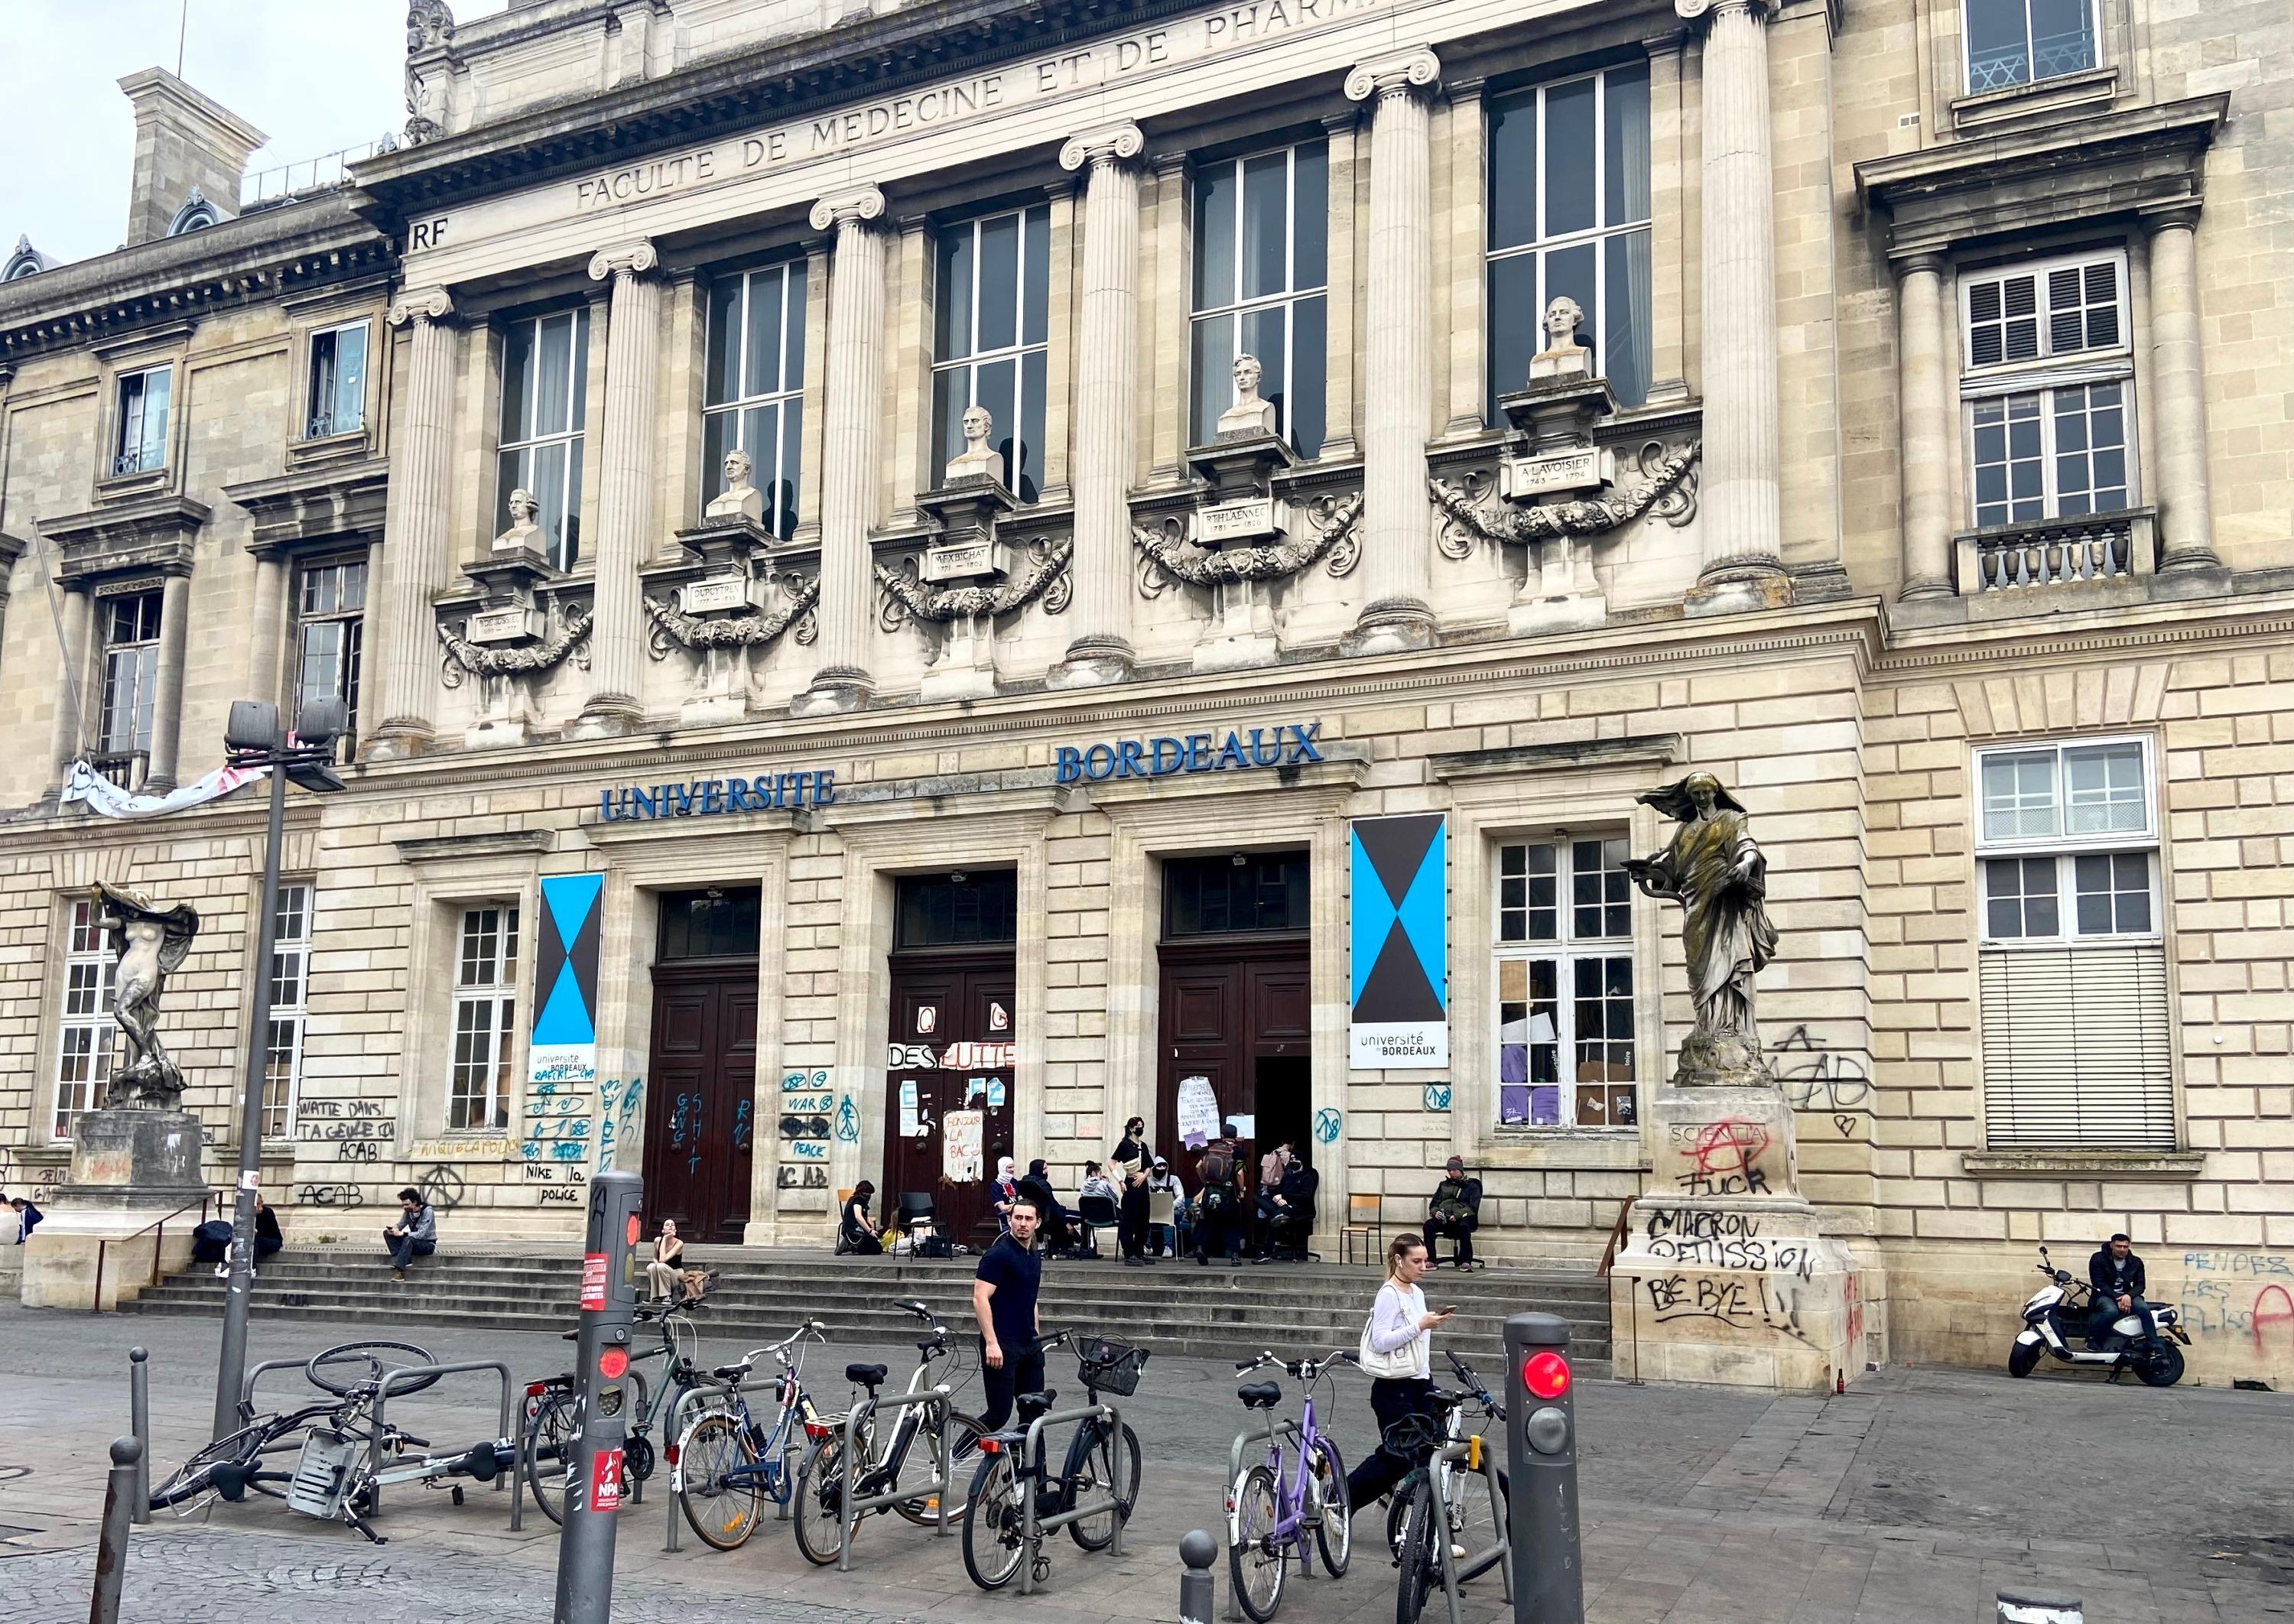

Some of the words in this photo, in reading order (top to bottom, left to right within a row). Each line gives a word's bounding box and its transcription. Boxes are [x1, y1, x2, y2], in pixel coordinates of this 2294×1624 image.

[576, 151, 715, 209] FACULTE
[742, 132, 787, 168] DE
[811, 75, 1003, 151] MEDECINE
[1036, 51, 1092, 93] ET
[1116, 31, 1168, 73] DE
[412, 218, 449, 250] RF
[1532, 457, 1591, 476] LAVOISIER
[694, 584, 739, 598] DUPUYTREN
[1054, 722, 1325, 783] BORDEAUX
[600, 769, 836, 821] UNIVERSITE
[919, 1007, 934, 1032] Q
[1360, 1031, 1424, 1046] université
[889, 1046, 937, 1070] DES
[1382, 1046, 1436, 1056] BORDEAUX
[550, 1064, 588, 1072] BORDEAUX
[349, 1100, 382, 1118] DANS
[788, 1098, 817, 1110] WAR
[297, 1123, 321, 1140] TA
[1671, 1127, 1764, 1142] SCIENTIA
[339, 1141, 378, 1164] ACAB
[794, 1142, 827, 1158] PEACE
[1675, 1150, 1772, 1197] FUCK
[298, 1184, 364, 1210] ACAB
[1647, 1208, 1759, 1243] MACRON
[598, 1483, 618, 1497] NPA
